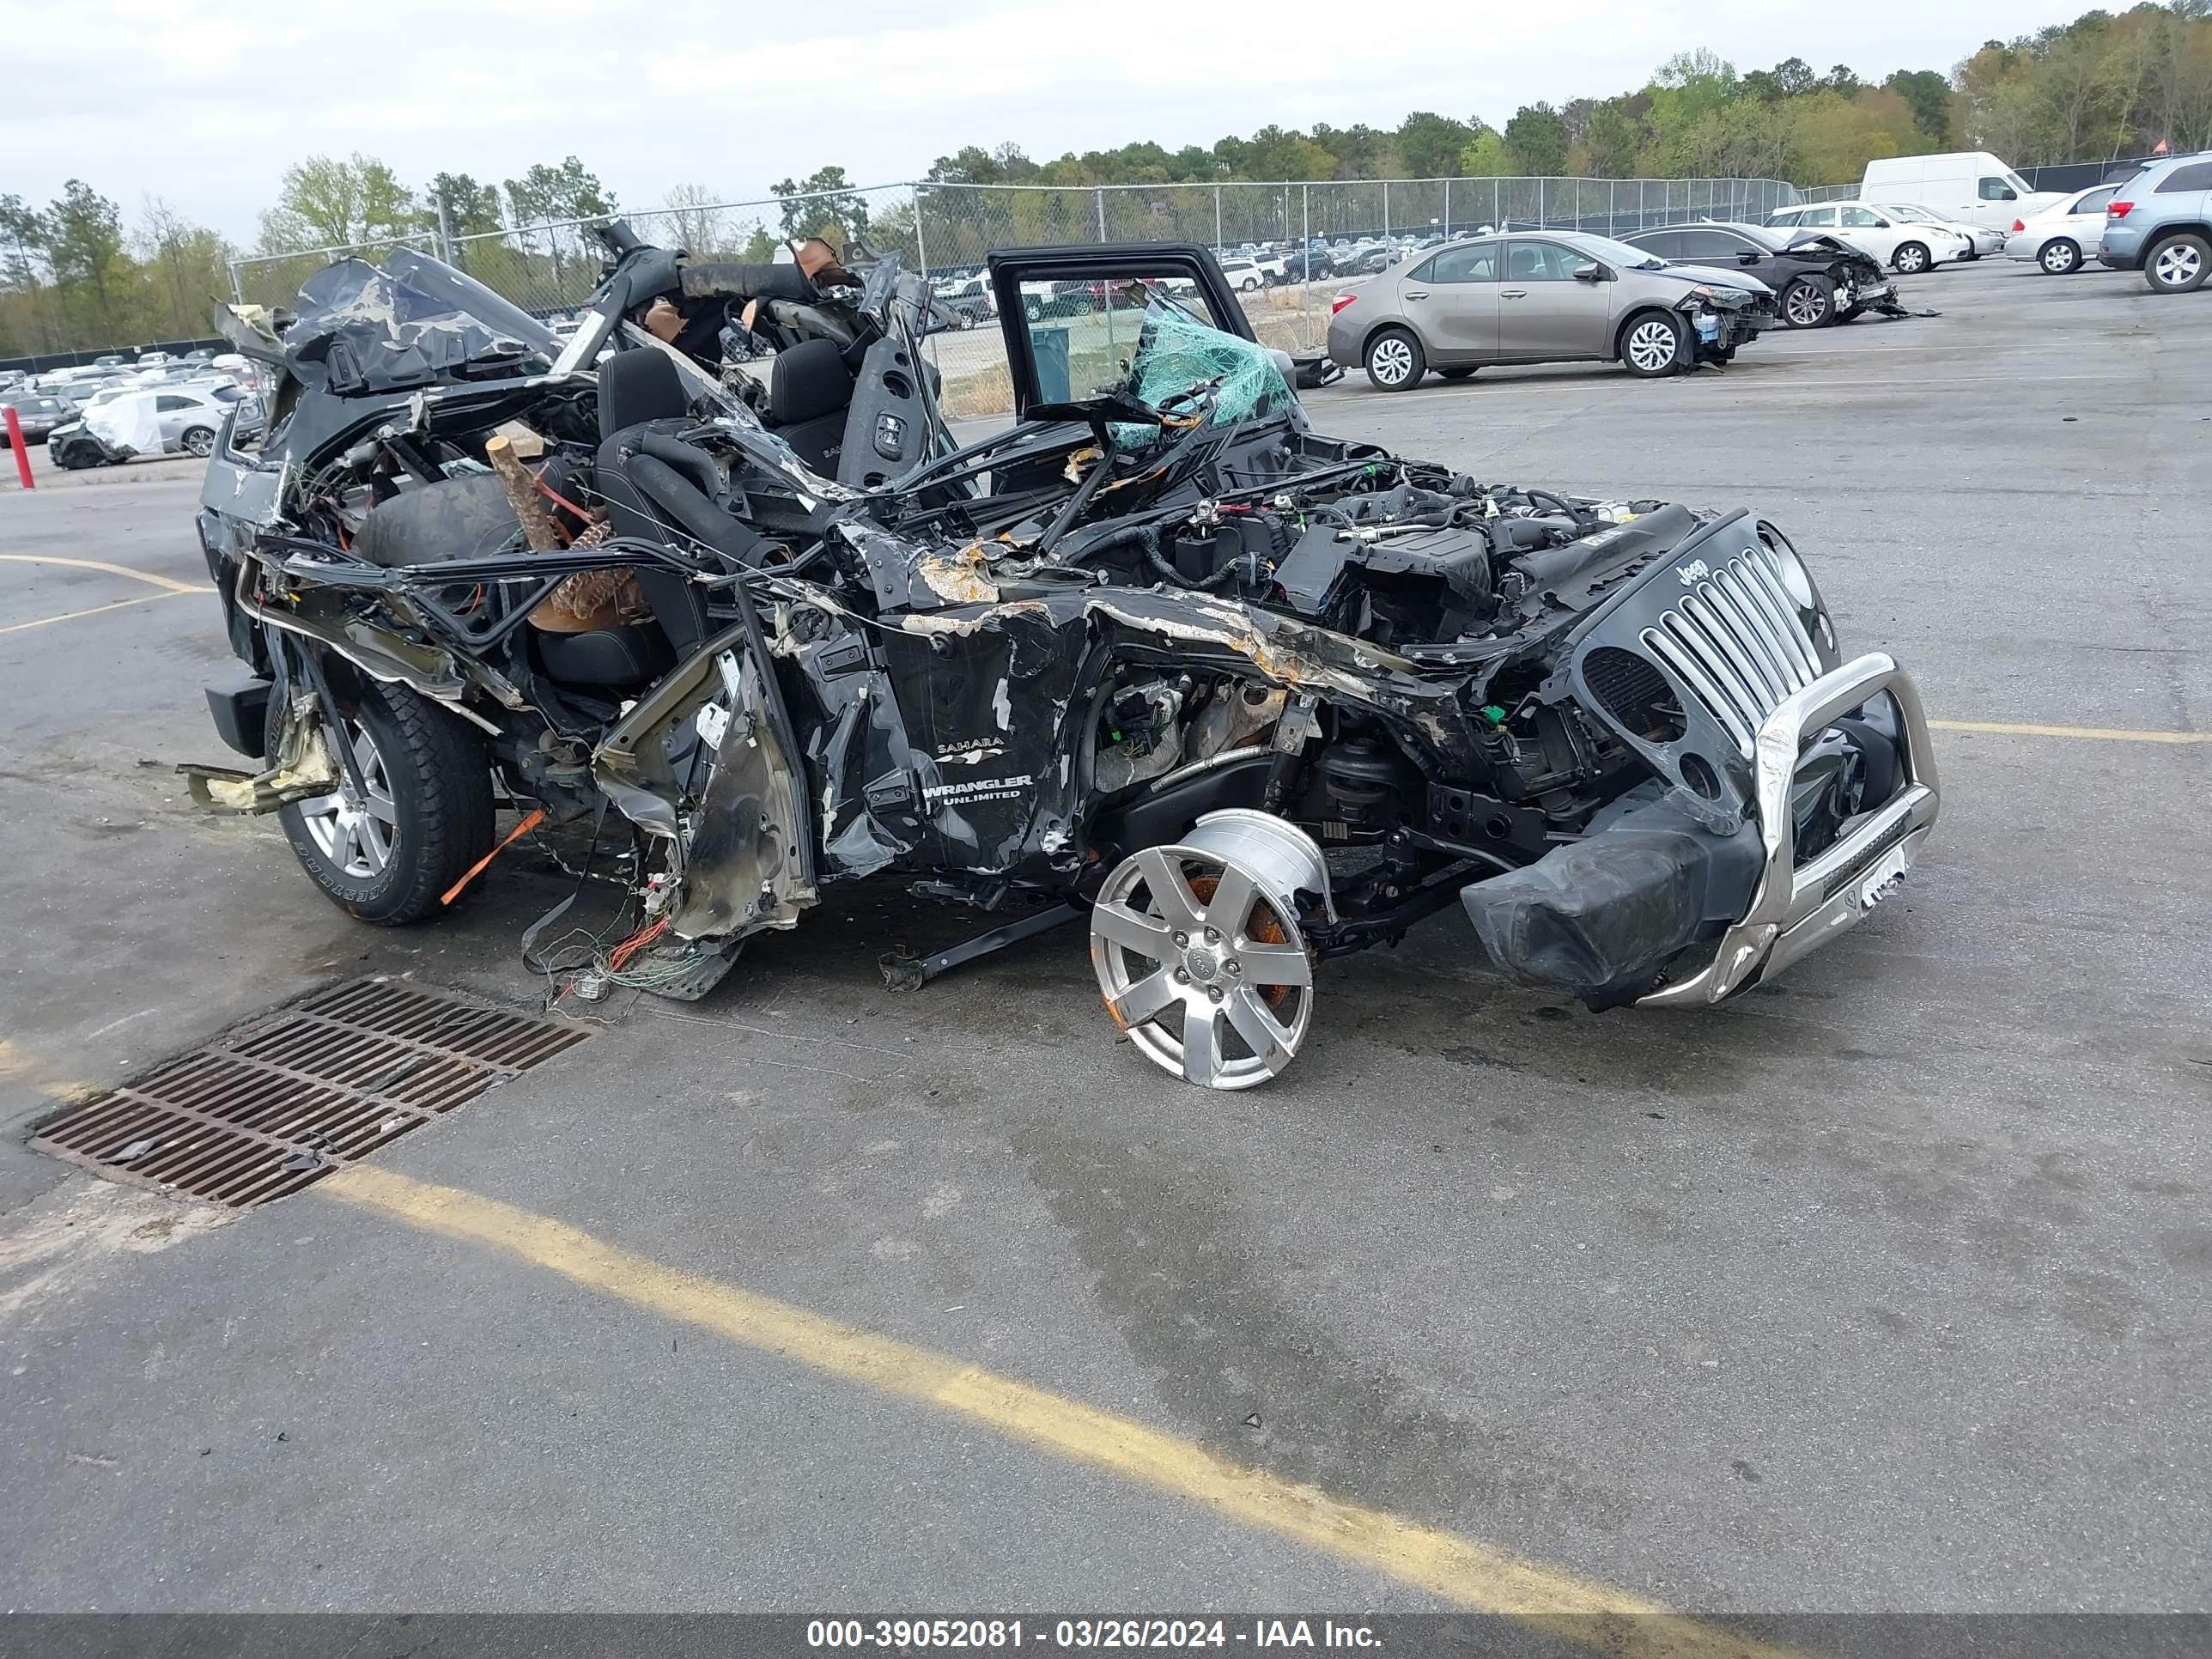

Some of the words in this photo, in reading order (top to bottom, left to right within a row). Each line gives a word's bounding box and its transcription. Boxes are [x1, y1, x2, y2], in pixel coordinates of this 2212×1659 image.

[1675, 559, 1710, 586] Jeep
[937, 737, 1005, 754] SAHARA
[922, 775, 1034, 799] WRANGLER
[943, 790, 1021, 805] UNLIMITED
